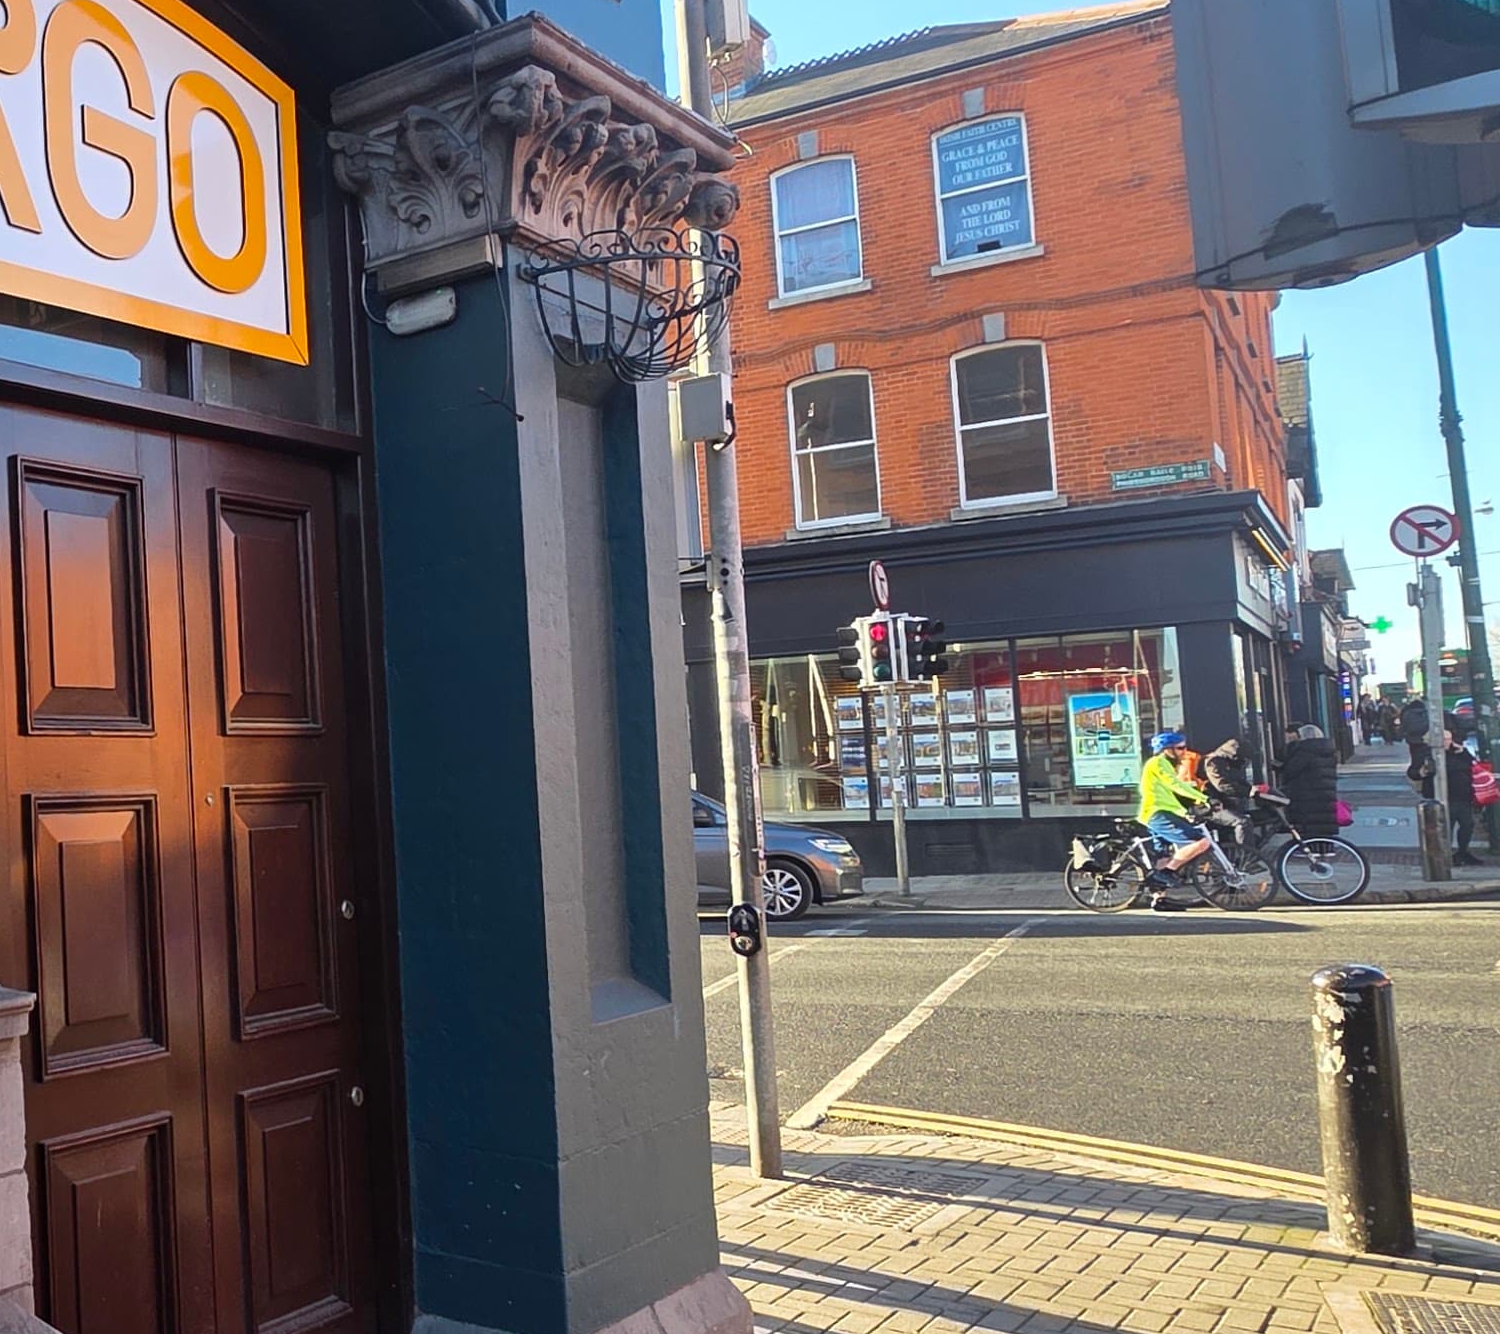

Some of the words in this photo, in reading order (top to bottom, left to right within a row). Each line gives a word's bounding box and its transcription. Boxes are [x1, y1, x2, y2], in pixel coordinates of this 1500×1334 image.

[941, 146, 974, 162] GRACE
[976, 143, 985, 154] &
[987, 134, 1020, 151] PEACE
[955, 156, 984, 173] FROM
[985, 151, 1008, 164] GOD
[952, 170, 974, 185] OUR
[974, 163, 1013, 177] FATHER
[960, 204, 981, 217] AND
[981, 196, 1011, 212] FROM
[962, 215, 981, 229] THE
[983, 210, 1011, 224] LORD
[954, 230, 983, 245] JESUS
[984, 220, 1020, 237] CHRIST
